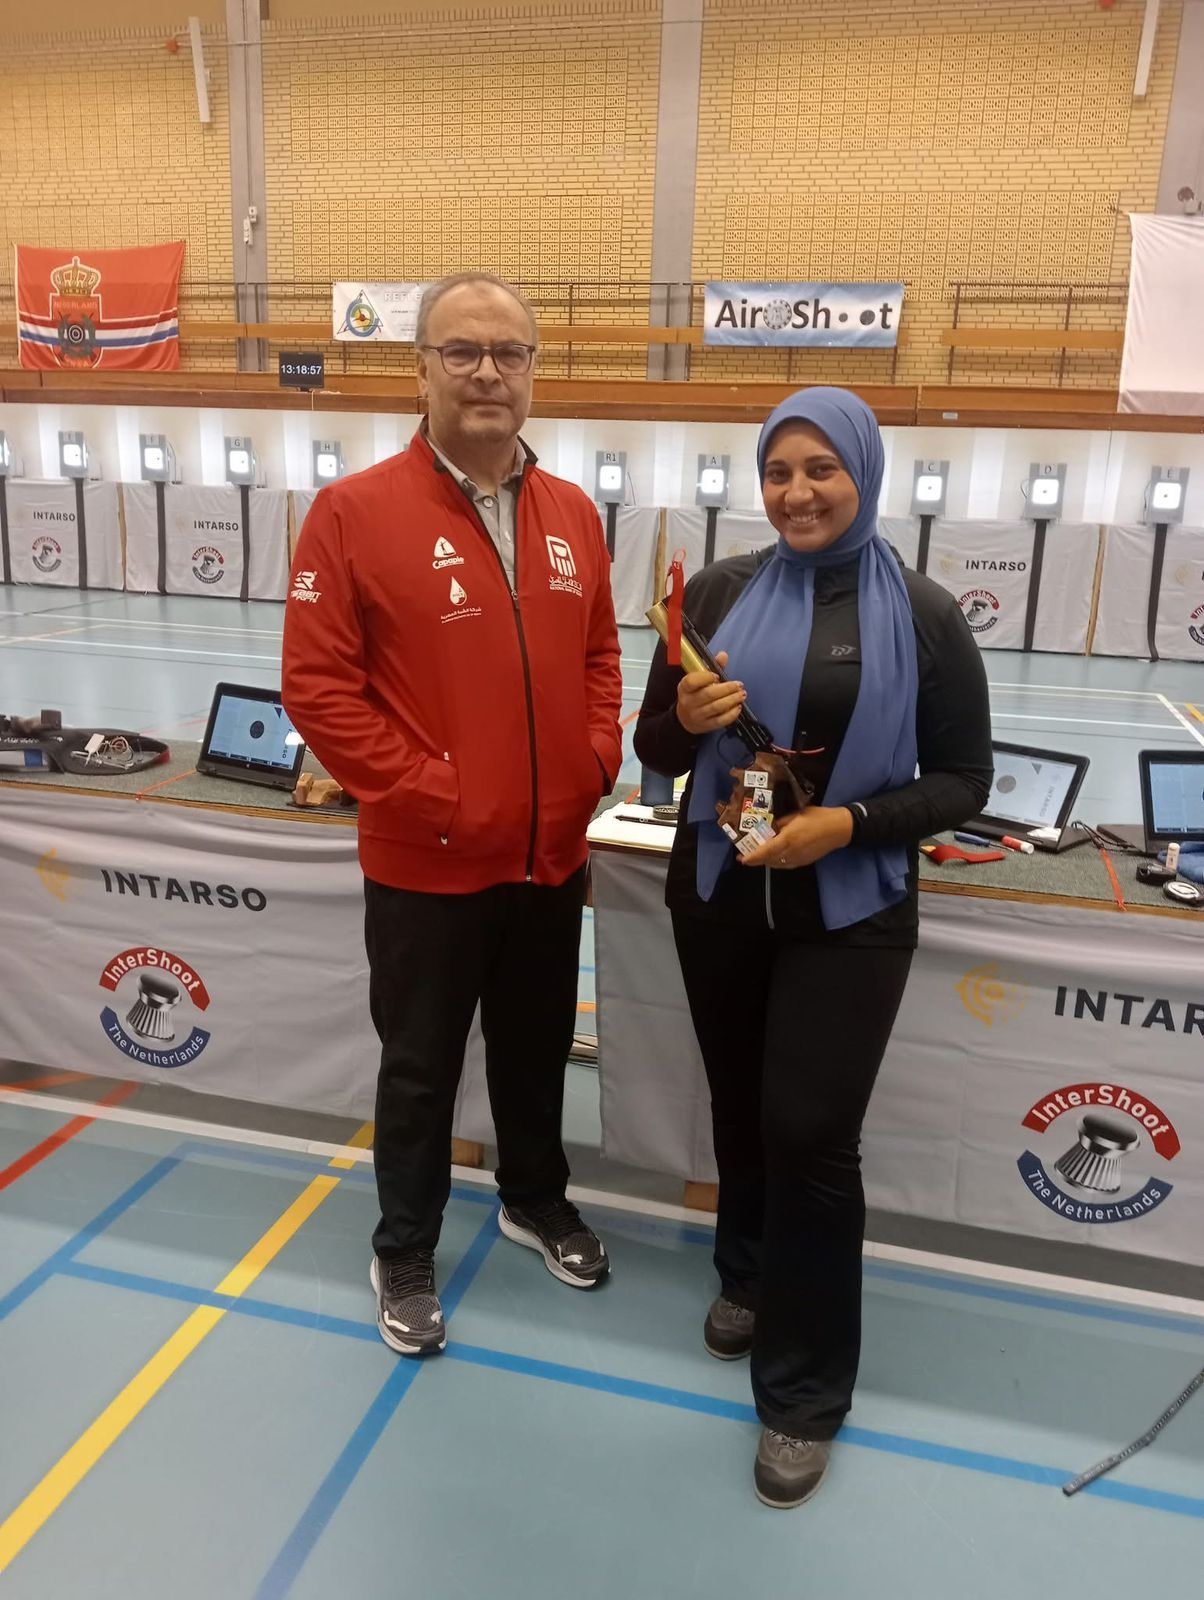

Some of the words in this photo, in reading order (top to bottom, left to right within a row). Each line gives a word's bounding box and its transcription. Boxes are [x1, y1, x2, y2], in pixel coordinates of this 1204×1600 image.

[281, 364, 322, 375] 13:18:57
[234, 438, 241, 447] G
[324, 443, 331, 451] H
[606, 453, 616, 462] R1
[710, 456, 717, 465] A
[1044, 465, 1052, 475] D
[33, 511, 76, 522] INTARSO
[193, 520, 239, 531] INTARSO
[965, 559, 1027, 572] INTARSO
[100, 868, 268, 912] INTARSO
[104, 949, 200, 992] InterShoot
[109, 1023, 127, 1048] The
[128, 1035, 205, 1066] Netherlands
[1031, 1085, 1169, 1137] InterShoot
[1027, 1169, 1051, 1198] The
[1051, 1188, 1162, 1221] Netherlands
